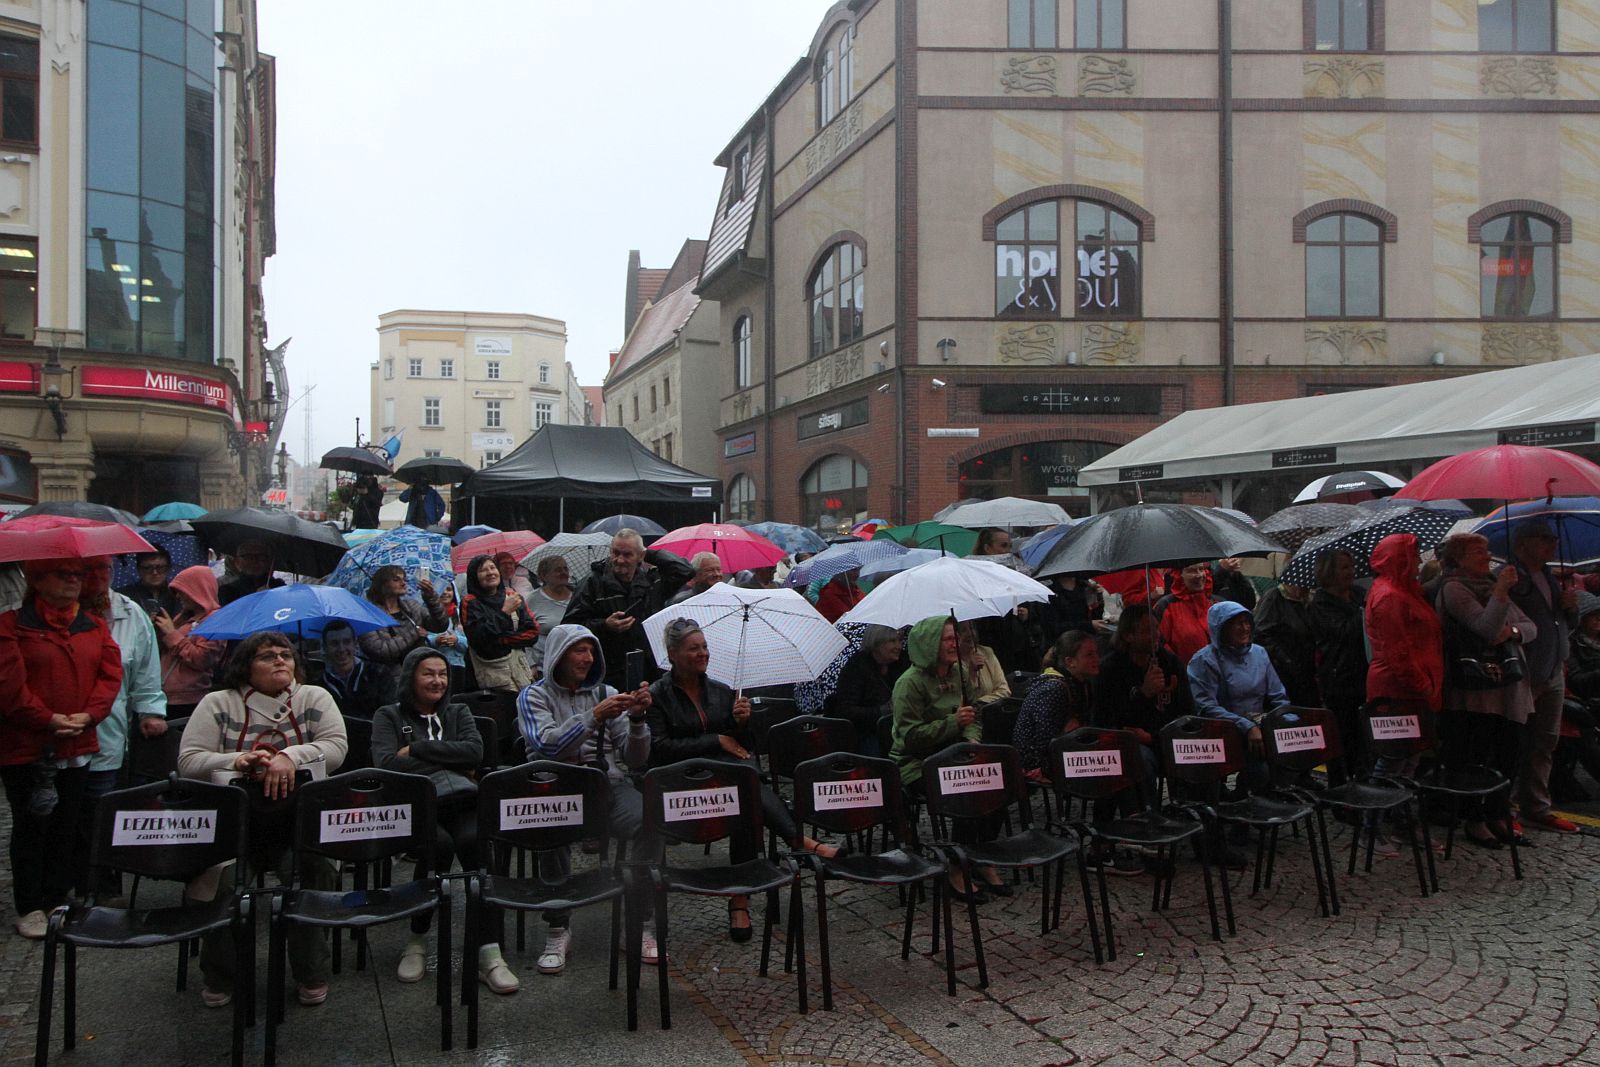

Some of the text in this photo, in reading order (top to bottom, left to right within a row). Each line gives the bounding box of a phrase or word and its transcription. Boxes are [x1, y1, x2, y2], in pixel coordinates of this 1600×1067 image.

[145, 369, 224, 399] Millennium
[1062, 455, 1076, 464] TU
[1041, 465, 1084, 473] WYGRY
[1054, 475, 1078, 484] SMA
[1066, 755, 1118, 767] REZERWACJA
[942, 766, 999, 781] REZERWACJA
[817, 782, 878, 796] REZERWACJA
[669, 793, 735, 809] REZERWACJA
[506, 801, 579, 817] REZERWACJA
[122, 817, 210, 831] REZERWACJA
[327, 809, 407, 826] REZERWACJA
